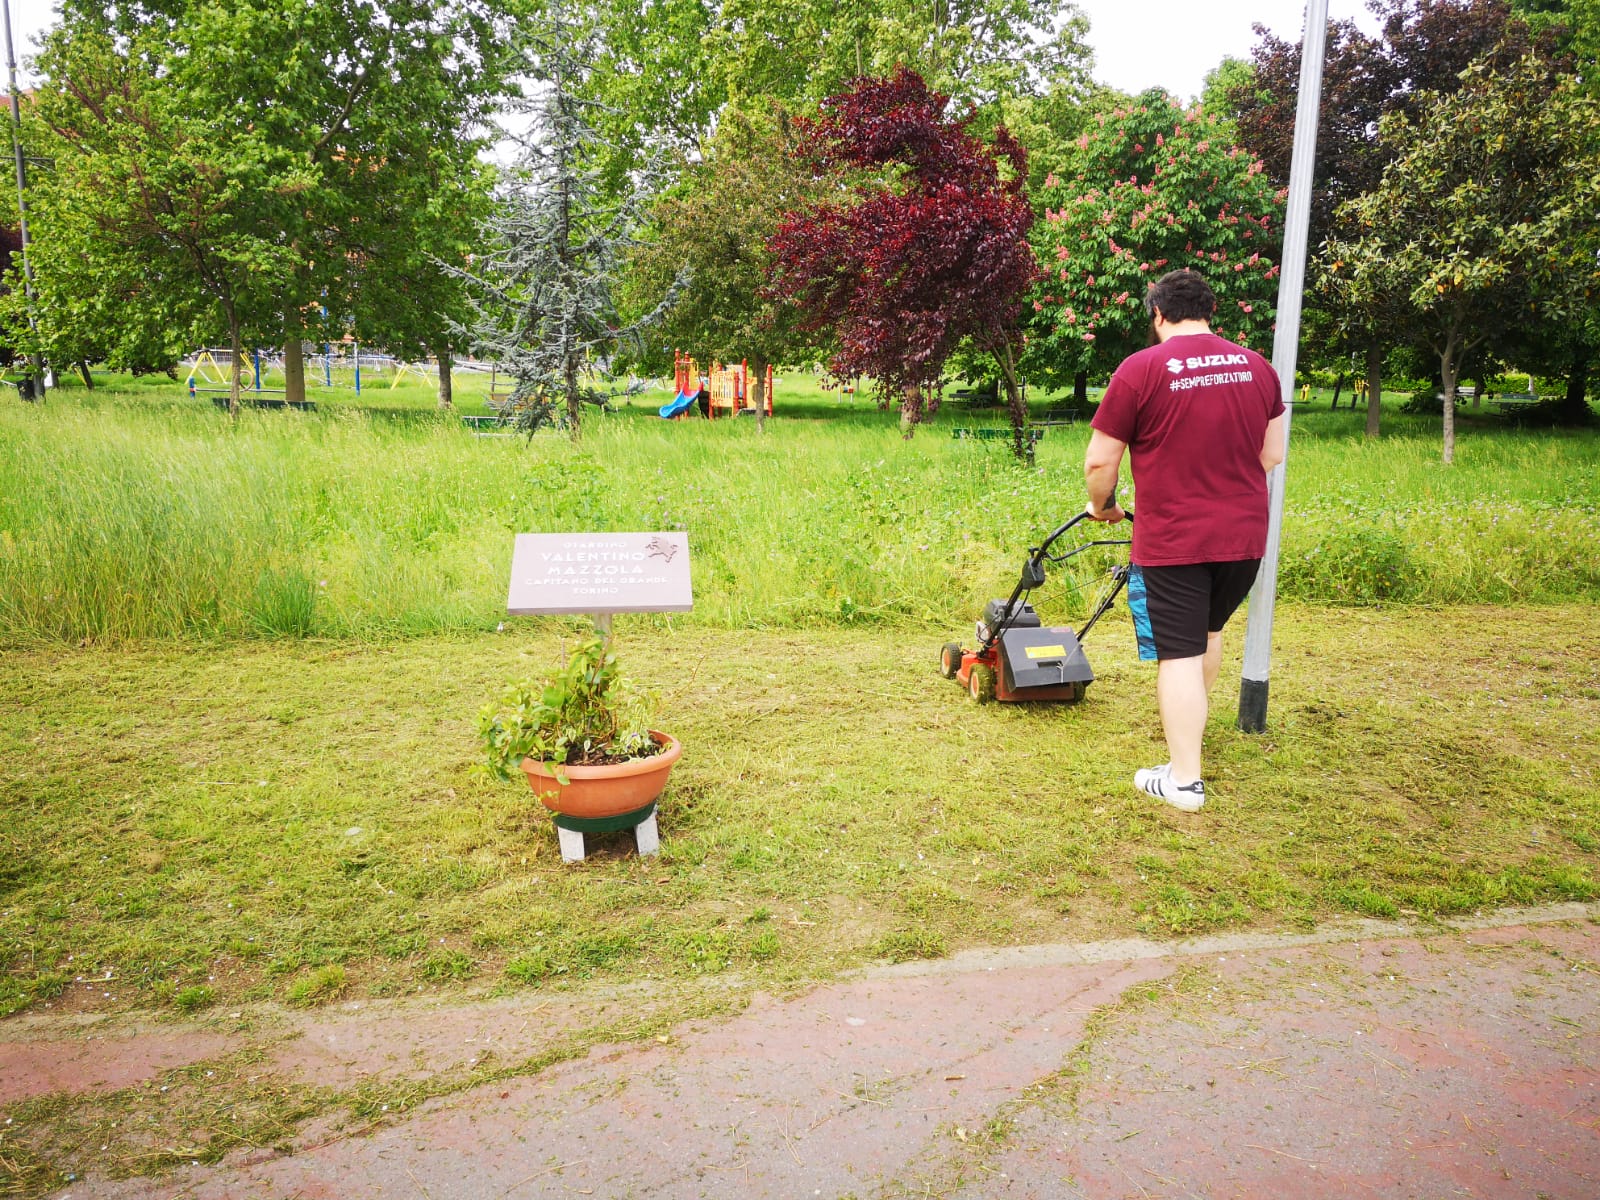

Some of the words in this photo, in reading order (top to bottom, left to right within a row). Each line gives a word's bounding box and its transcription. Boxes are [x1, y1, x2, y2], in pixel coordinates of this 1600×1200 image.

[1185, 354, 1249, 369] SUZUKI
[563, 541, 628, 549] GIARDINO
[541, 552, 646, 562] VALENTINO
[547, 564, 644, 575] MAZZOLA
[525, 577, 589, 585] CAPITANO
[620, 576, 669, 584] GRANDE
